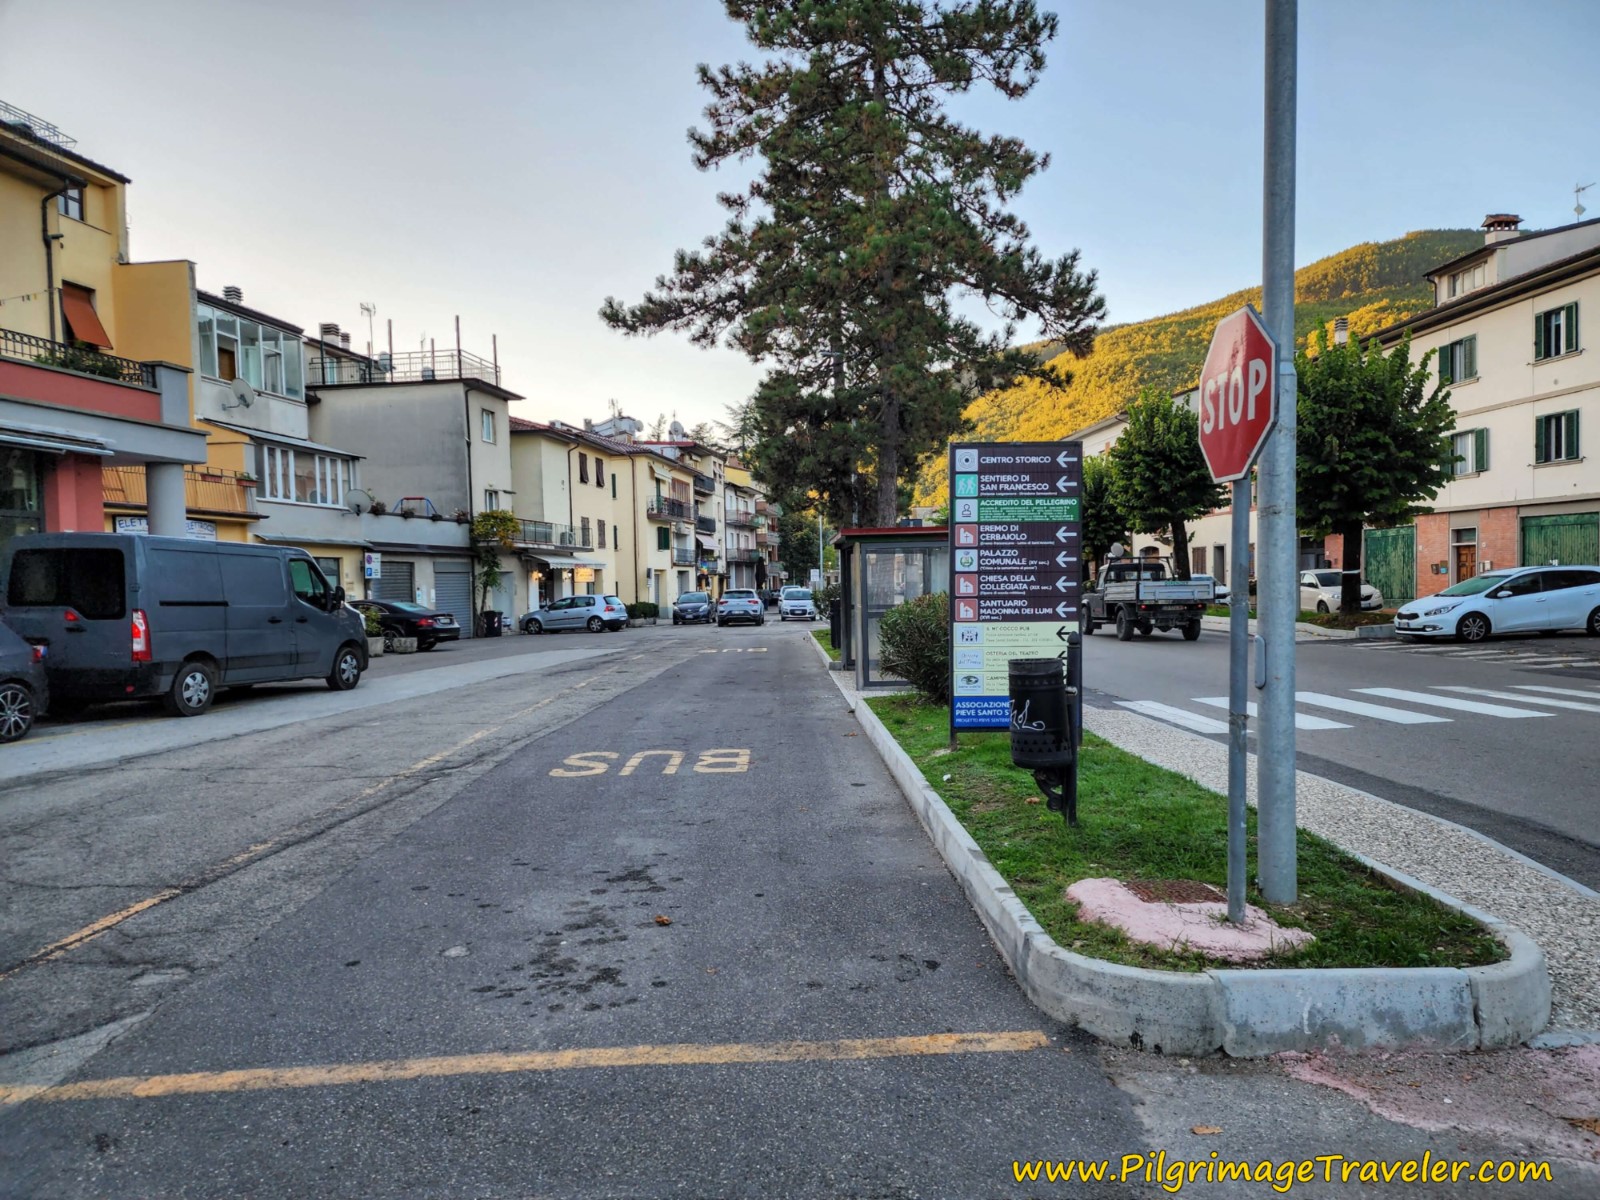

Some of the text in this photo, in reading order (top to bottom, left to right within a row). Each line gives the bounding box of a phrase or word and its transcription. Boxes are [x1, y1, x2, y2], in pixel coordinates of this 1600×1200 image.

[1202, 358, 1267, 435] STOP
[980, 456, 1051, 464] CENTRO STORICO
[980, 474, 1030, 482] SENTIERO DI
[980, 483, 1049, 491] SAN FRANCESCO
[1035, 498, 1077, 506] PELLEGRINO
[980, 533, 1027, 541] CERBAIOLO
[980, 549, 1018, 557] PALAZZO
[980, 558, 1027, 566] COMUNALE
[980, 574, 1036, 582] CHIESA DELLA
[980, 599, 1028, 607] SANTUARIO
[955, 701, 1010, 709] ASSOCIAZIONE
[548, 748, 752, 777] BUS
